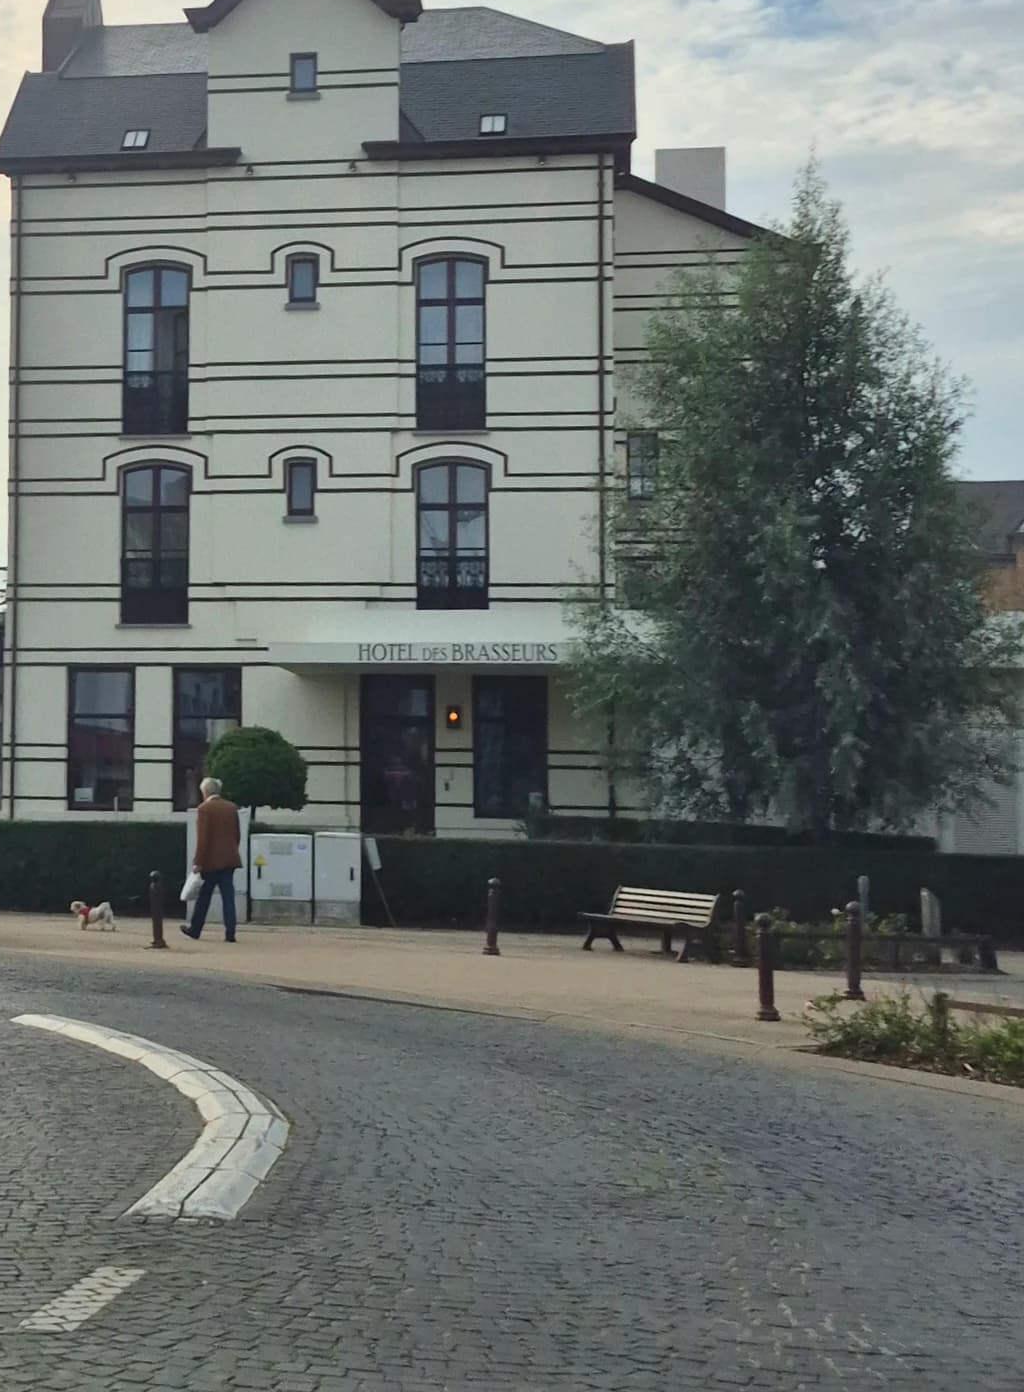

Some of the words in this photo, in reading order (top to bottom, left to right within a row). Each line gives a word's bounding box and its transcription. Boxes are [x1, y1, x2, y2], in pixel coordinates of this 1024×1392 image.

[357, 643, 417, 662] HOTEL
[422, 647, 447, 662] DES
[451, 643, 558, 662] BRASSEURS
